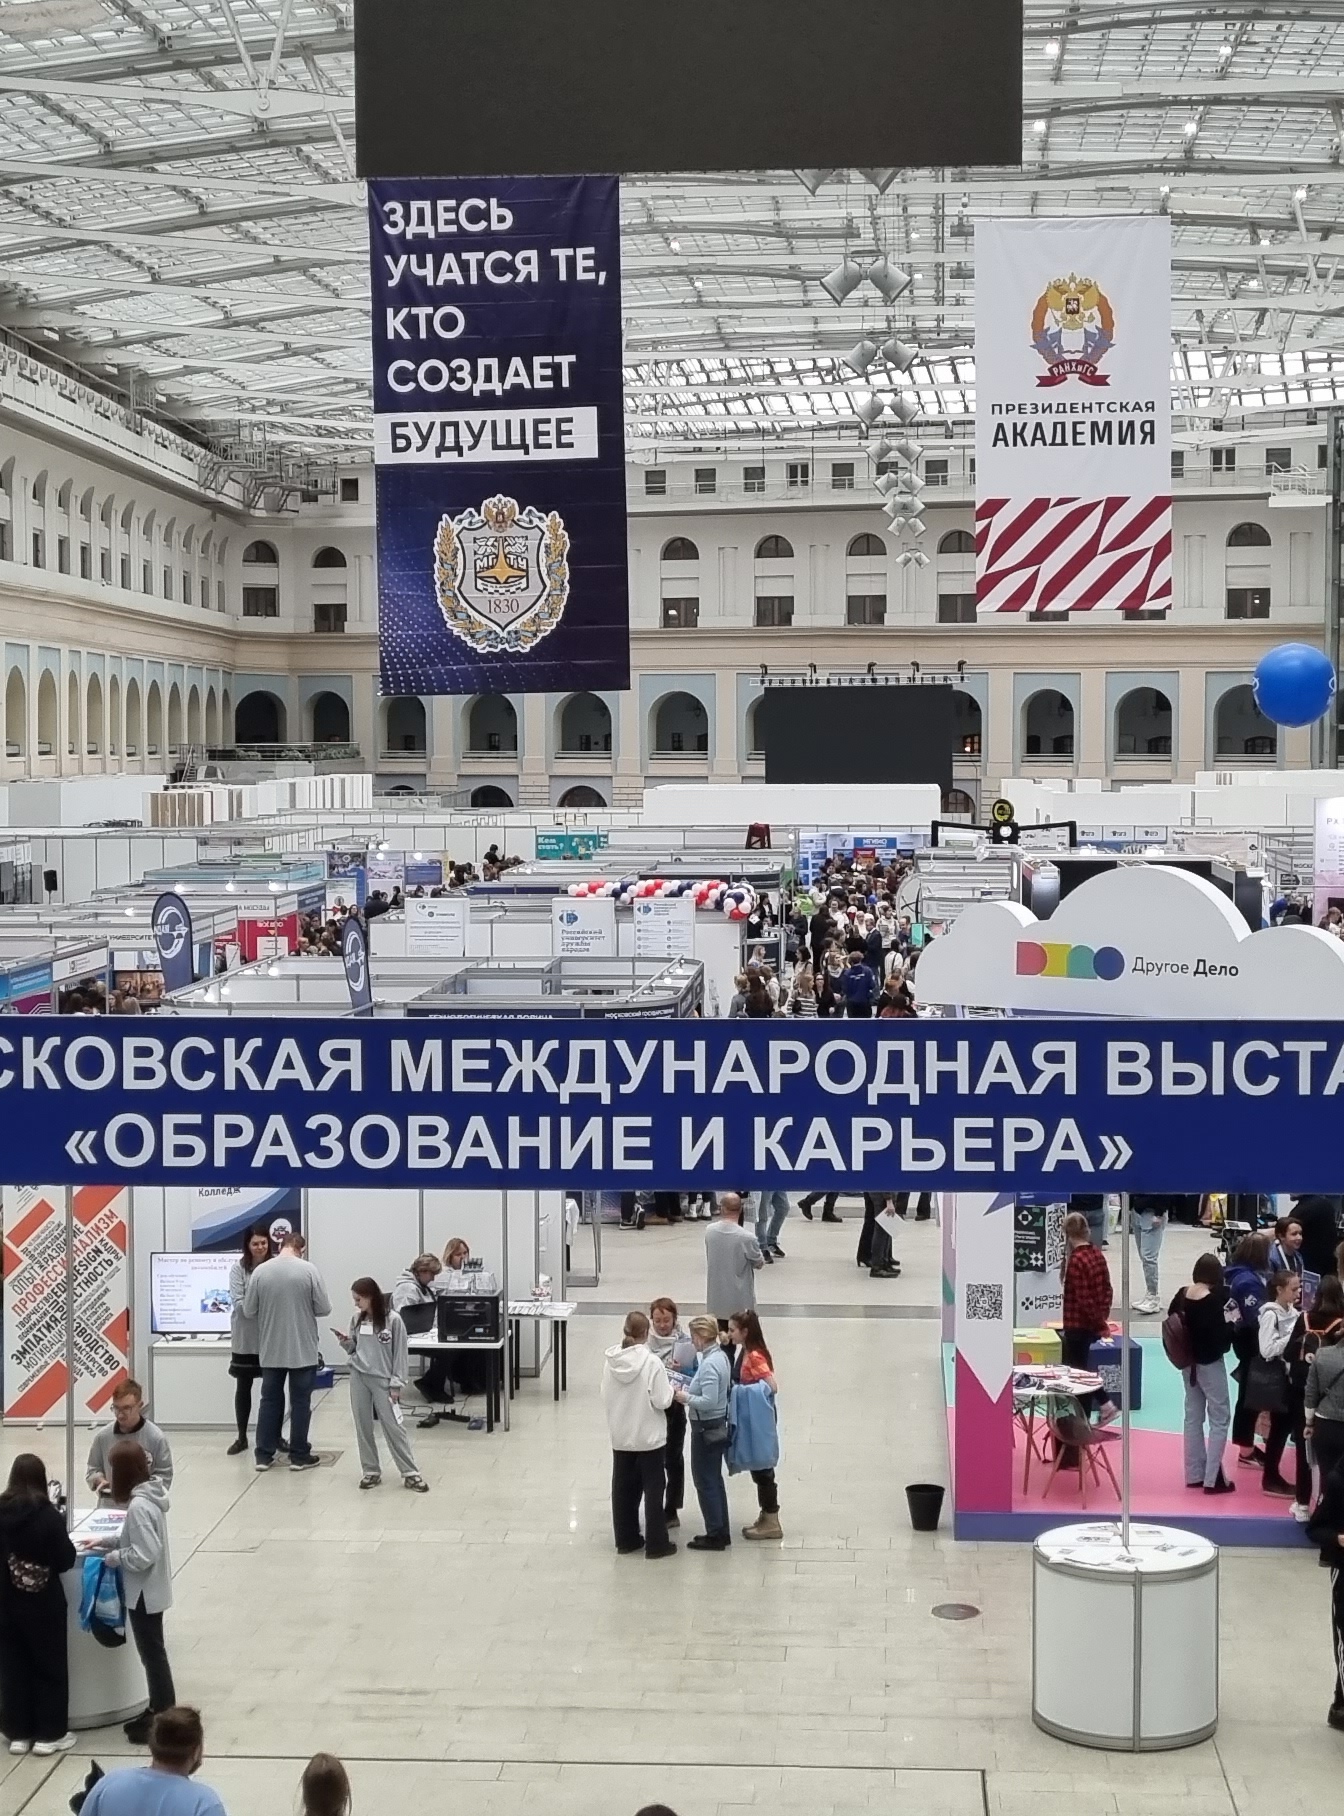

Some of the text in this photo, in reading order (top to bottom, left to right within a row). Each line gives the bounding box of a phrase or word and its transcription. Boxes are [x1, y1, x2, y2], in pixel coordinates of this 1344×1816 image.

[382, 198, 514, 239] ЗДЕСЬ
[385, 247, 607, 287] УЧАТСЯ ТЕ,
[386, 306, 466, 340] КТО
[387, 355, 576, 396] СОЗДАЕТ
[991, 400, 1155, 416] ПРЕЗИДЕНТСКАЯ
[390, 416, 575, 458] БУДУЩЕЕ
[992, 420, 1155, 448] АКАДЕМИЯ
[487, 598, 520, 614] 1830
[1131, 957, 1239, 978] Другое Дело
[390, 1039, 1077, 1106] МЕЖДУНАРОДНАЯ
[65, 1113, 1133, 1173] «ОБРАЗОВАНИЕ И КАРЬЕРА»
[198, 1187, 241, 1198] Колледж
[11, 1208, 119, 1318] ПРОФЕССИНАЛИЗМ
[98, 1236, 123, 1262] КАДРЫ
[11, 1264, 41, 1296] ОПЫТ
[16, 1292, 54, 1330] ТВОРЧЕСТВО
[11, 1313, 61, 1365] ЭМПАТИЯ
